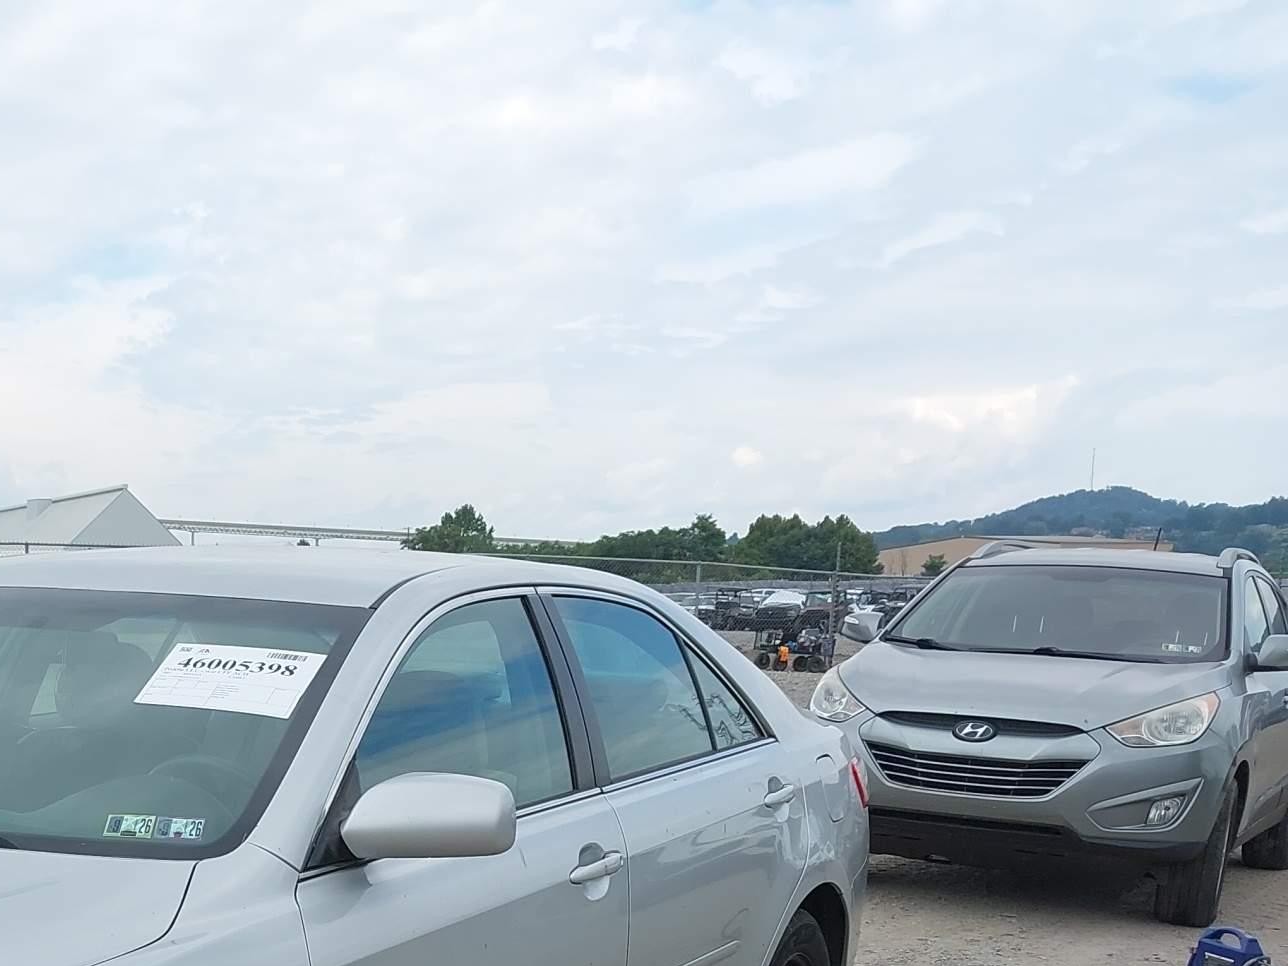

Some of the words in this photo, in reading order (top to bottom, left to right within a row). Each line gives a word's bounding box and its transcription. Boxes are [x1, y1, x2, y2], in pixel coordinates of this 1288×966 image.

[177, 657, 298, 677] 46005398
[138, 818, 152, 834] 26
[188, 820, 202, 837] 26
